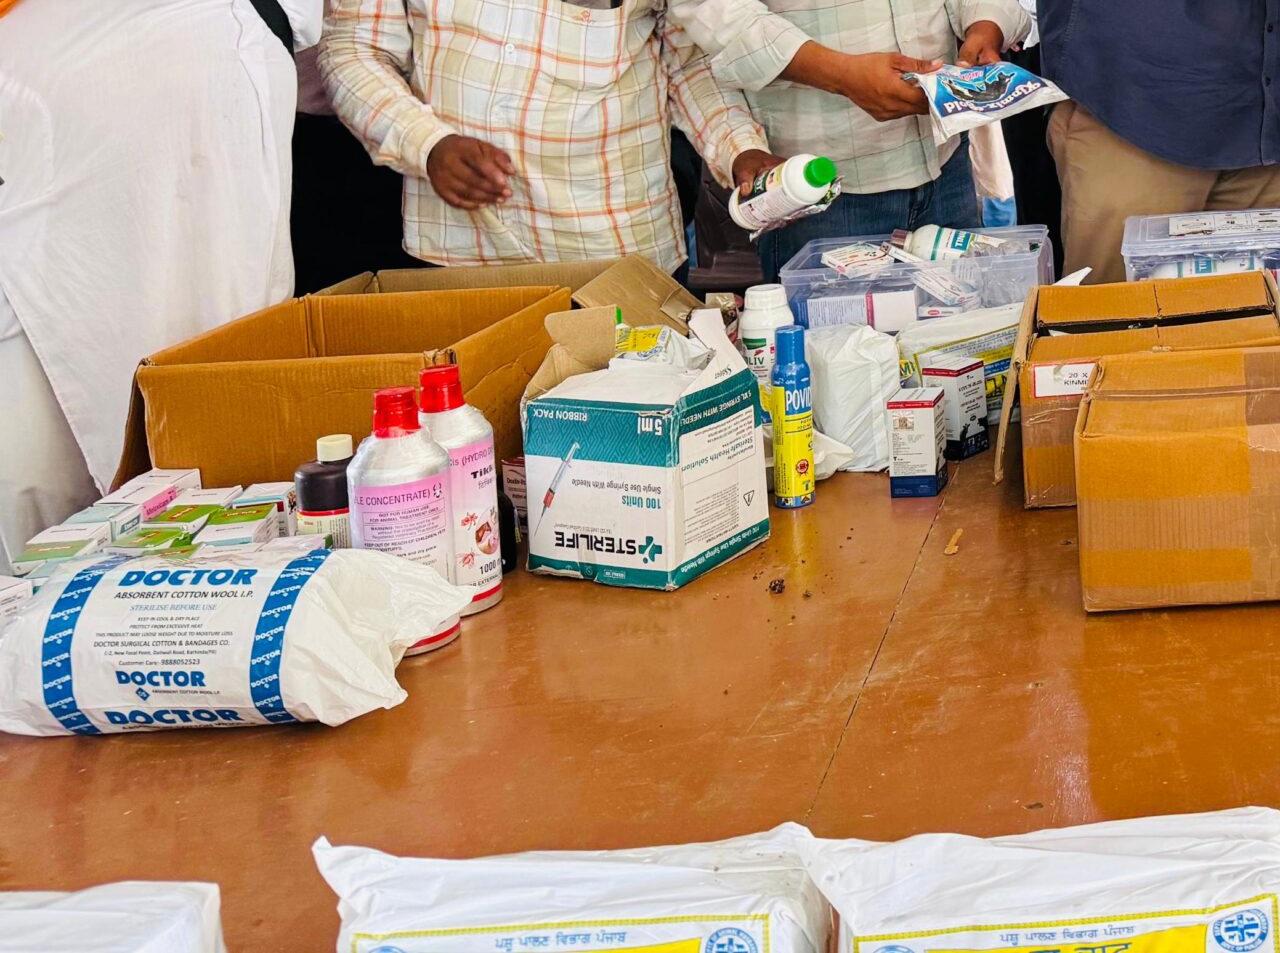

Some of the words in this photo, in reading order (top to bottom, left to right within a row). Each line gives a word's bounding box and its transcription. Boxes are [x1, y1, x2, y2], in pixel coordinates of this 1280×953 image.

[719, 395, 741, 411] SYRINGE
[533, 408, 555, 419] PACK
[556, 410, 588, 423] RIBBON
[703, 405, 718, 417] WITH
[711, 448, 731, 462] Health
[571, 478, 590, 488] Needle
[591, 480, 605, 489] With
[607, 481, 629, 492] Syringe
[629, 484, 640, 493] Use
[641, 485, 661, 495] Single
[366, 489, 431, 506] CONCENTRATE)
[622, 495, 644, 509] Units
[645, 497, 661, 509] 100
[554, 531, 636, 555] STERILIFE
[480, 560, 497, 576] 1000
[680, 562, 698, 573] Needle
[118, 569, 258, 587] DOCTOR
[114, 591, 169, 600] ABSORBENT
[171, 591, 208, 599] COTTON
[210, 591, 239, 599] WOOL
[270, 585, 302, 596] DOCTOR
[130, 604, 168, 612] STERILISE
[261, 604, 292, 617] DOCTOR
[255, 626, 285, 641] DOCTOR
[152, 640, 177, 648] COTTON
[251, 650, 281, 665] DOCTOR
[116, 670, 207, 687] DOCTOR
[250, 674, 279, 688] DOCTOR
[104, 709, 245, 725] DOCTOR
